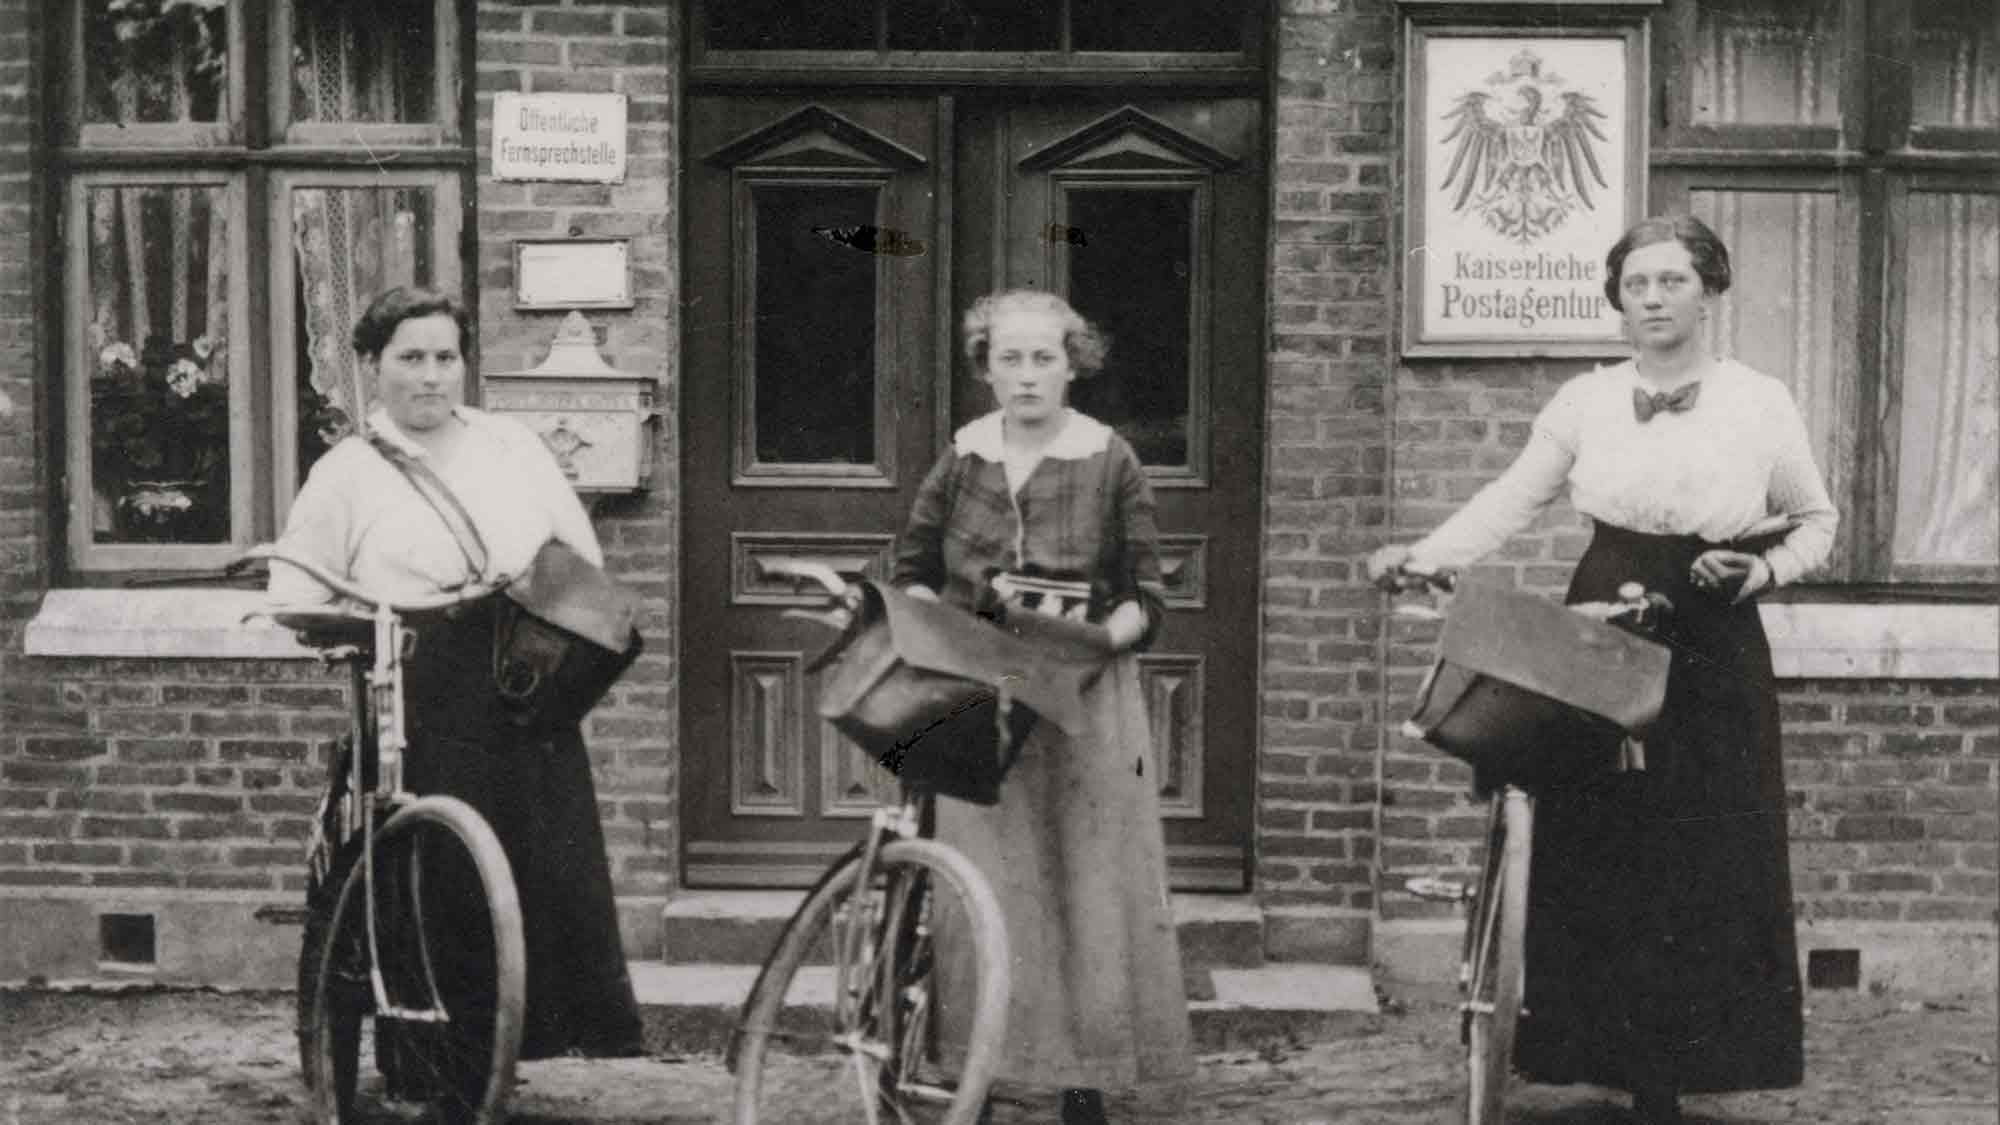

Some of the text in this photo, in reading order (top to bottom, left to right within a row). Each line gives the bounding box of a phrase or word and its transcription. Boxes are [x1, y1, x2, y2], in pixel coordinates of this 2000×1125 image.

[501, 137, 617, 167] Fernsprechstelle
[1455, 252, 1598, 280] Kaiserliche
[1440, 284, 1606, 328] Postagentur
